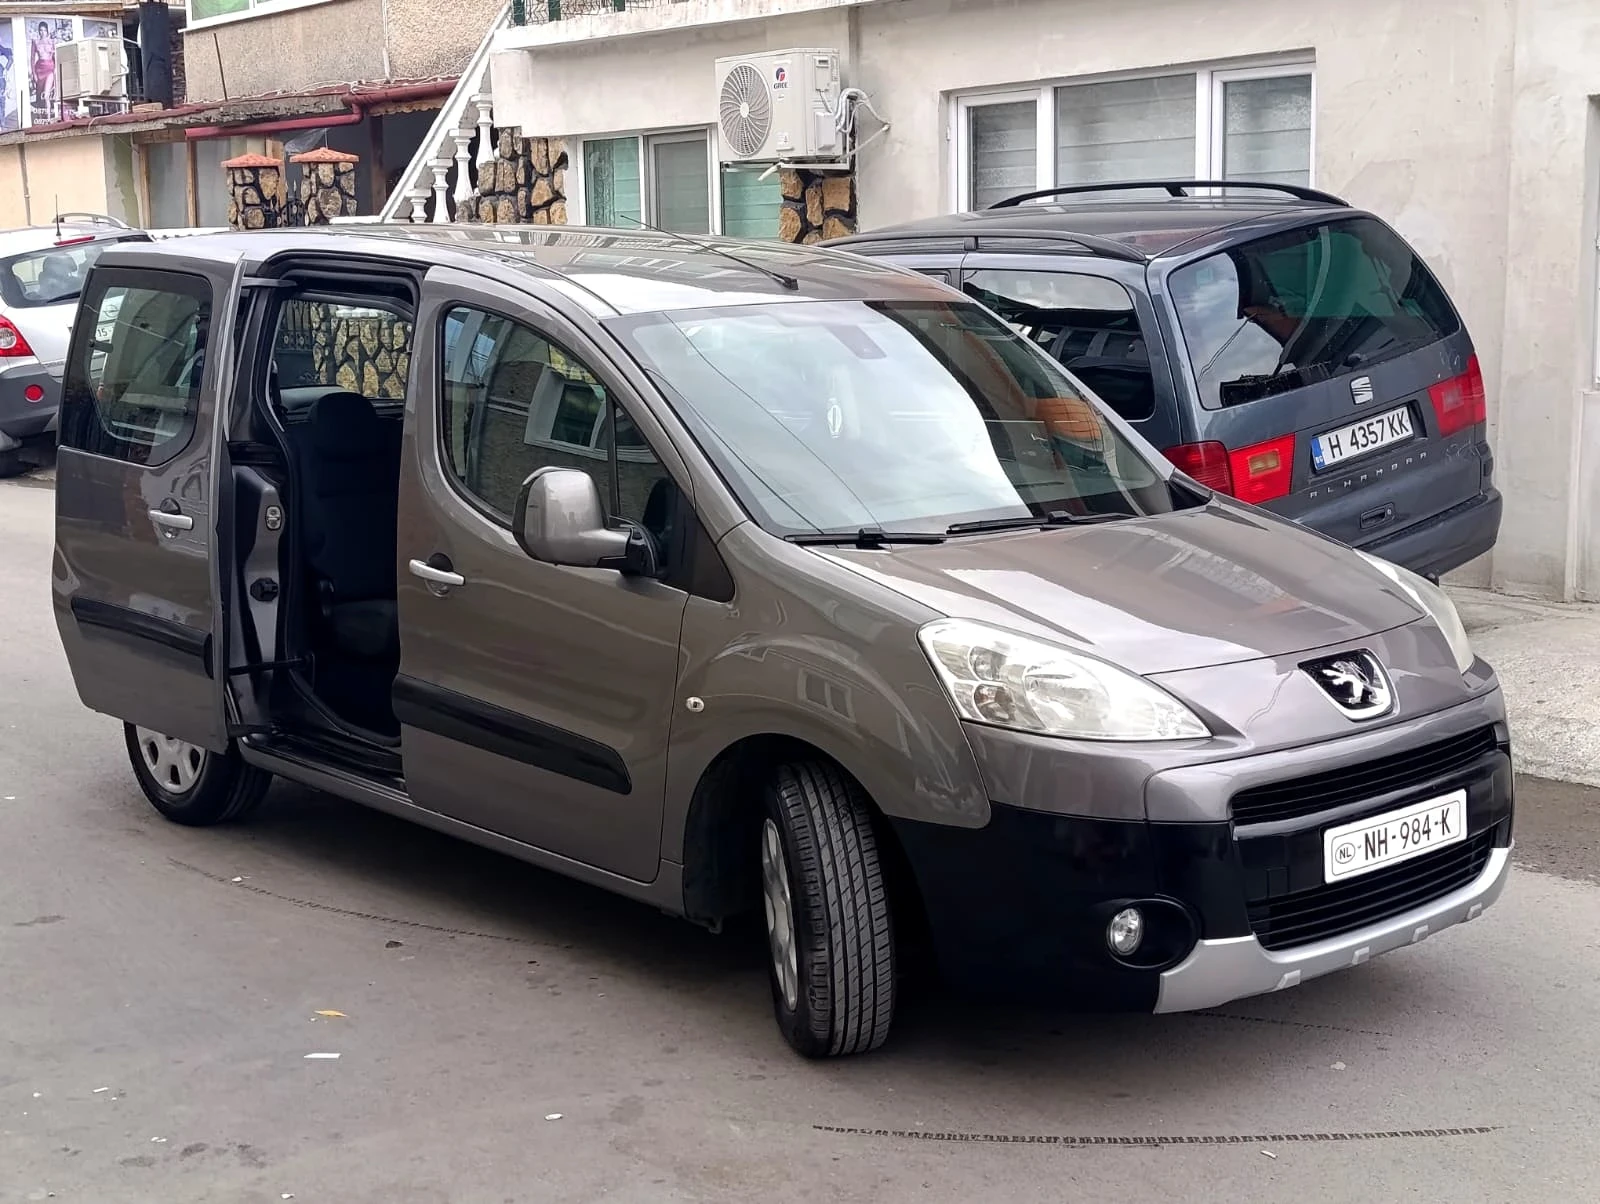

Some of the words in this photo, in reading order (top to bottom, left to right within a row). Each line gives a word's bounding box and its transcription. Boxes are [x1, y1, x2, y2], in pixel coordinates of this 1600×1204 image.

[1350, 418, 1385, 451] 4357
[1309, 451, 1427, 499] ALHAMBRA
[1339, 847, 1352, 860] NL
